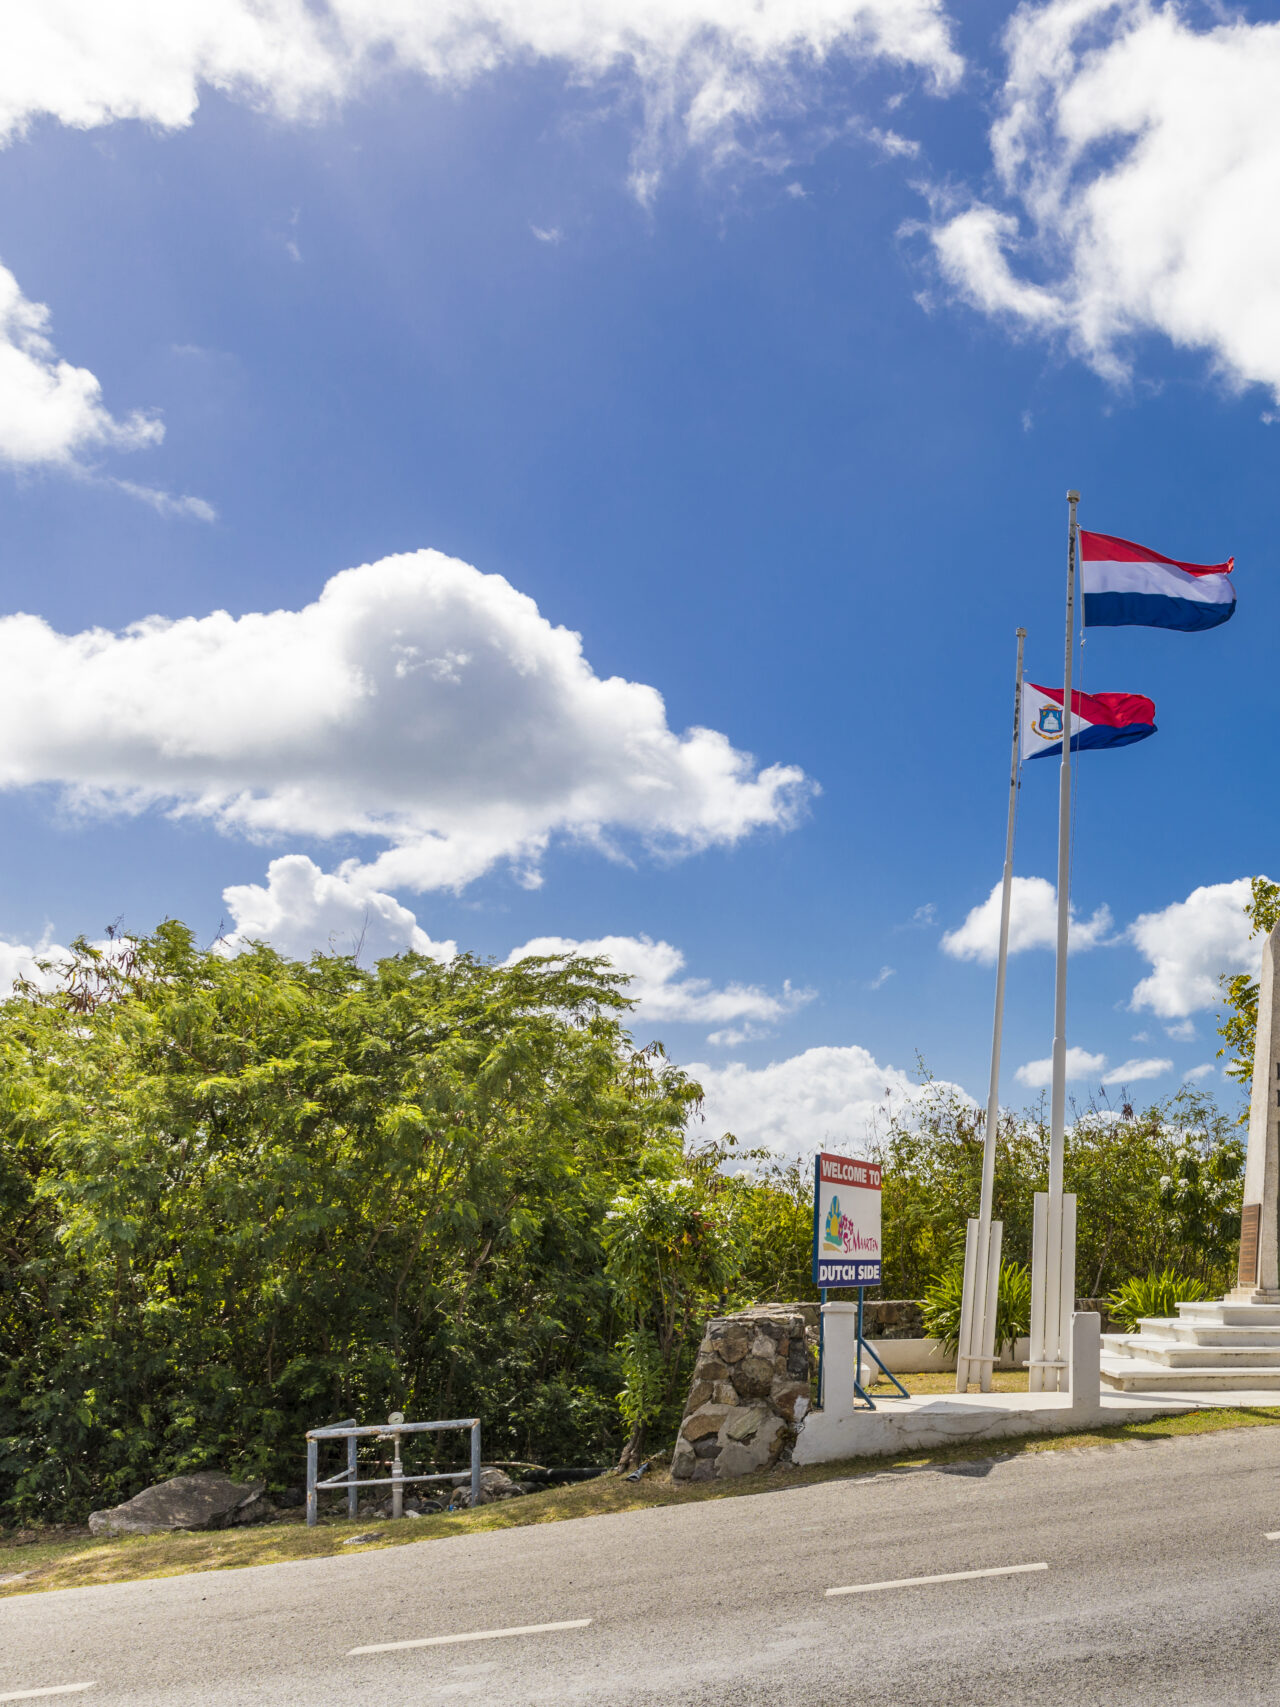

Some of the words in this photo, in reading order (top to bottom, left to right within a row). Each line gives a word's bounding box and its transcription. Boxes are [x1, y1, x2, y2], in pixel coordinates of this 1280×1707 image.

[823, 1160, 867, 1184] WELCOME
[869, 1170, 880, 1185] TO
[820, 1265, 855, 1281] DUTCH
[858, 1265, 879, 1279] SIDE
